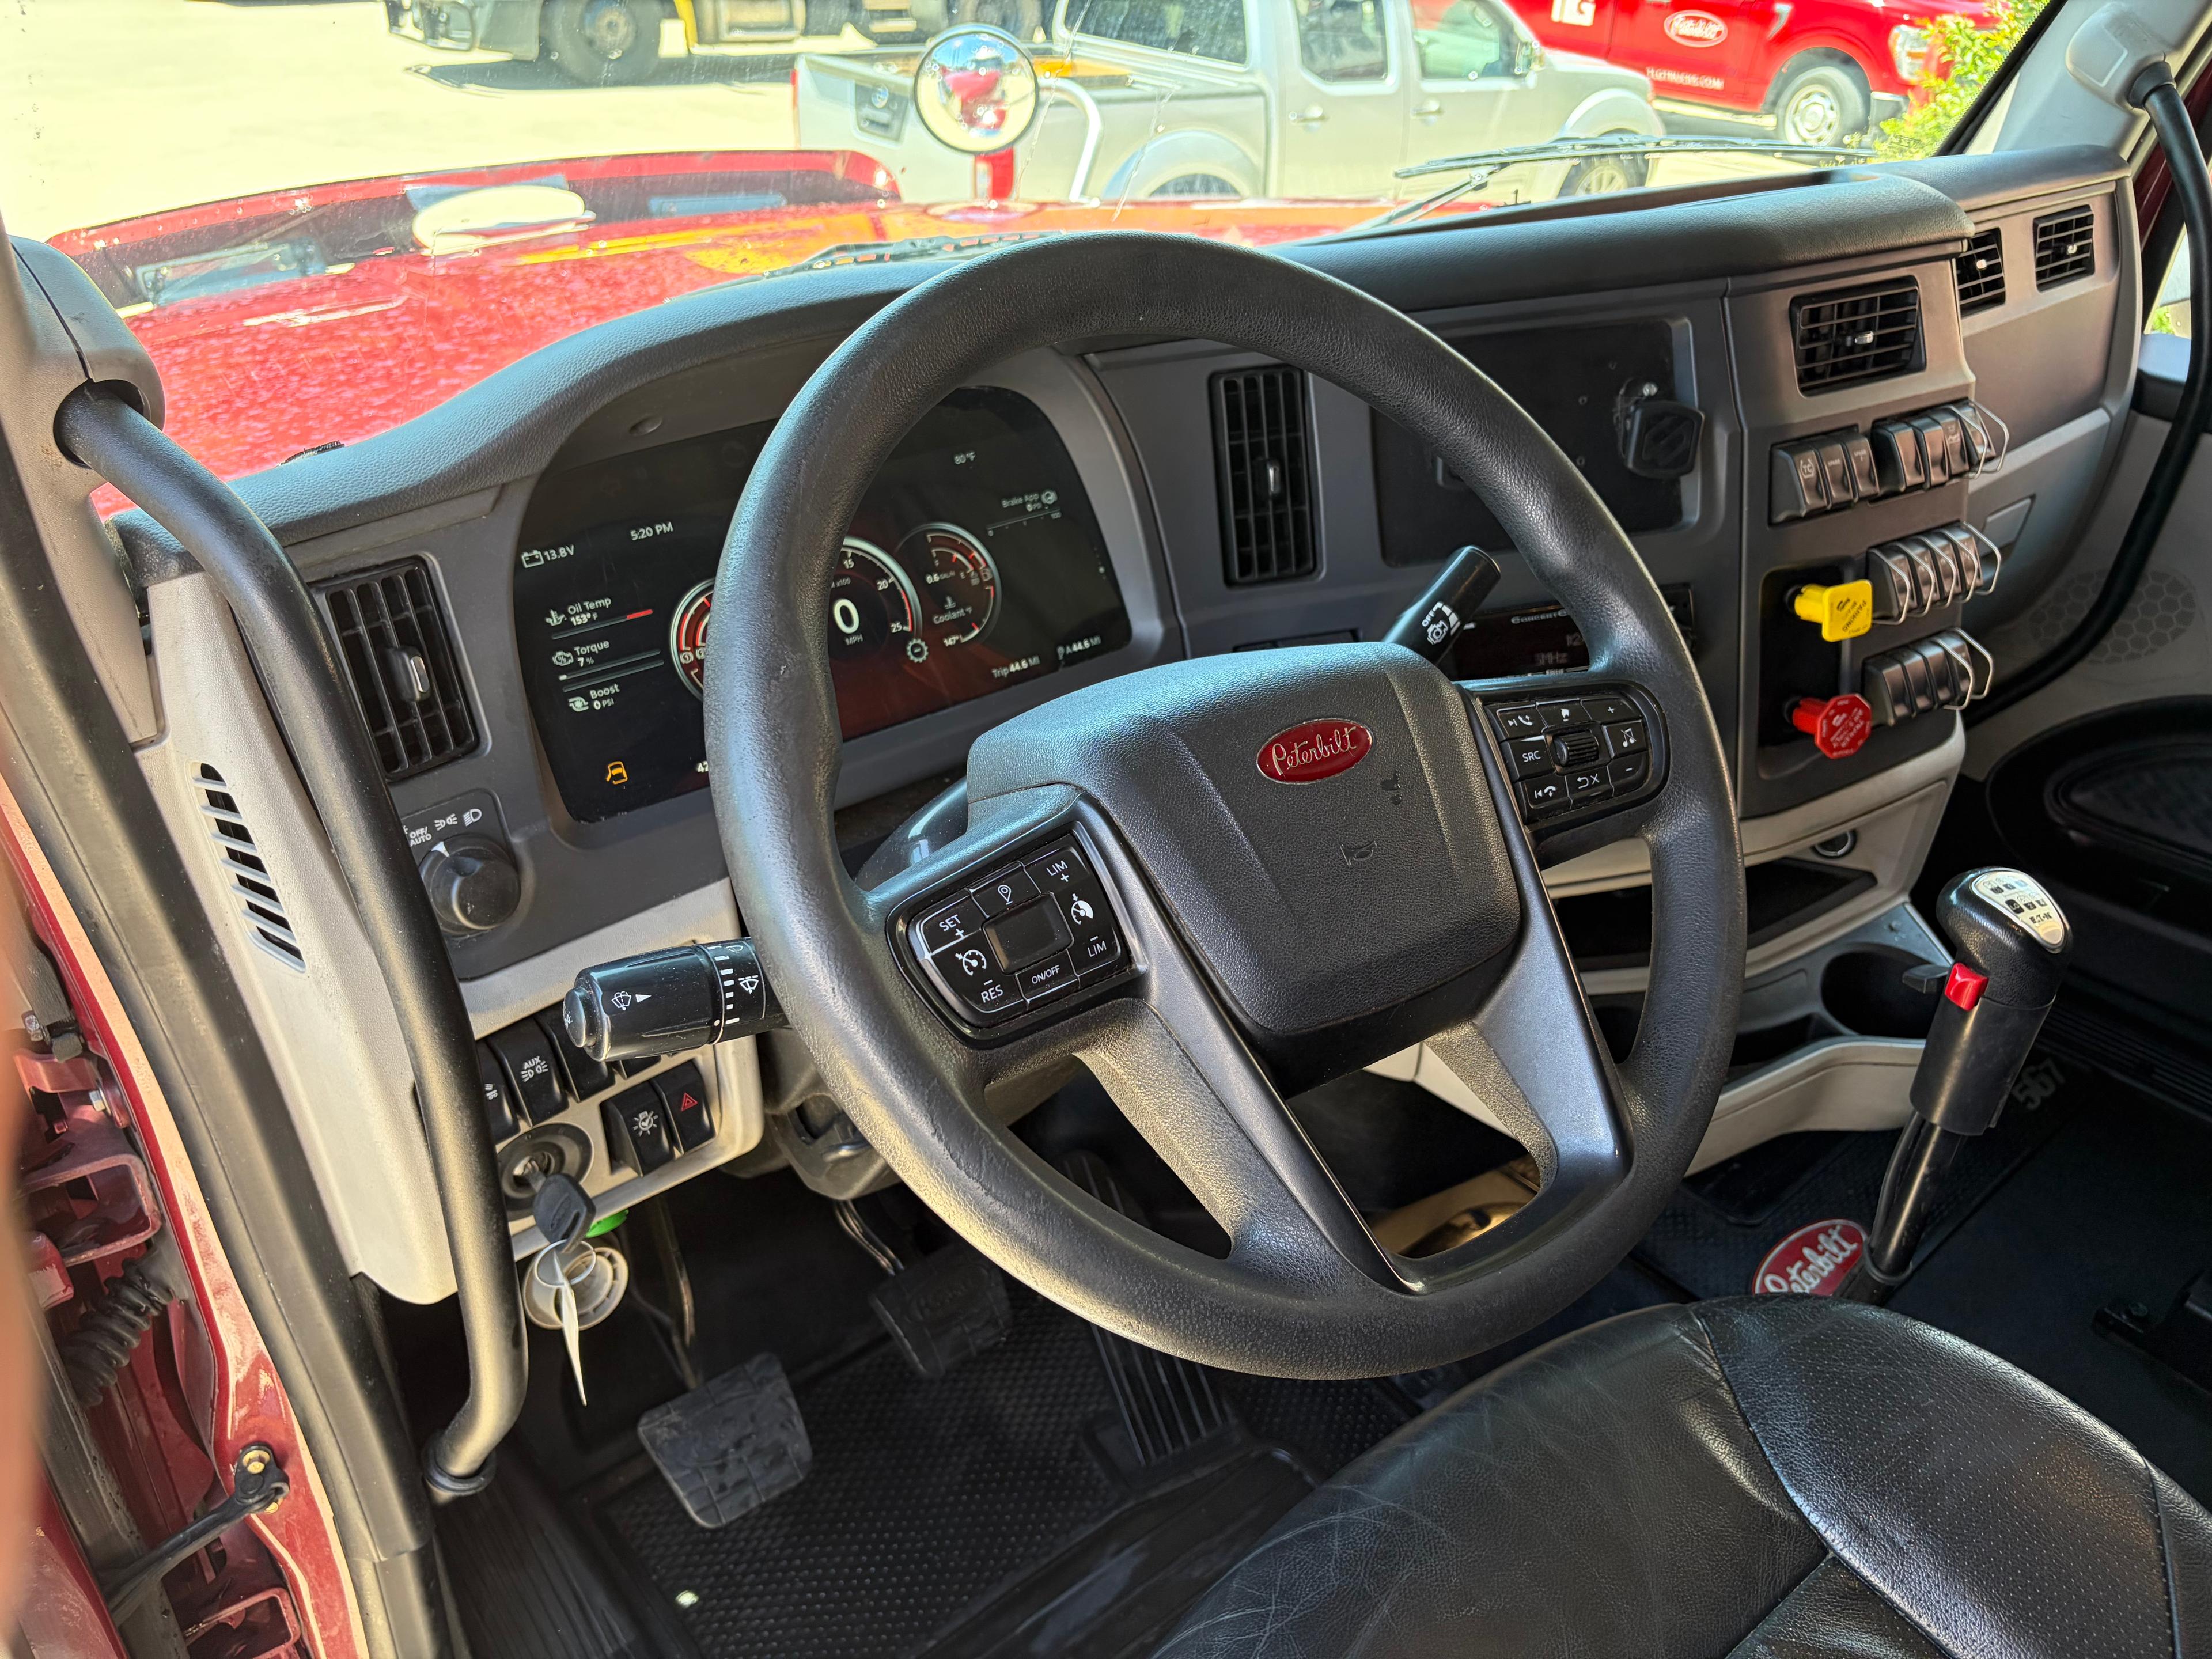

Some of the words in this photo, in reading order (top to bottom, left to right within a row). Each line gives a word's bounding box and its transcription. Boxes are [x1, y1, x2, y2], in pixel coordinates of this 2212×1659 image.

[630, 527, 653, 540] 5:20
[655, 521, 673, 535] PM
[544, 544, 575, 561] 13.8V
[843, 559, 854, 569] 15
[876, 580, 889, 590] 20
[567, 602, 581, 615] Oil
[583, 597, 612, 610] Temp
[833, 598, 859, 634] 0
[933, 609, 965, 624] Coolant
[1422, 609, 1434, 627] OFF
[891, 622, 903, 633] 25
[574, 640, 610, 656] Torque
[844, 634, 863, 646] MPH
[1072, 638, 1091, 652] 44.6
[1090, 635, 1101, 646] MI
[577, 657, 584, 667] 7
[991, 668, 1009, 678] Trip
[1009, 658, 1029, 673] 44.6
[1028, 655, 1040, 667] MI
[590, 683, 620, 699] Boost
[593, 700, 601, 710] 0
[602, 698, 614, 708] PSI
[1272, 726, 1357, 776] Peterbilt
[1522, 751, 1541, 762] SRC
[409, 833, 432, 847] AUTO
[410, 826, 428, 839] OFF/
[1046, 859, 1068, 877] LIM
[938, 914, 961, 933] SET
[1088, 940, 1107, 958] LIM
[1031, 965, 1060, 985] ON/OFF
[980, 984, 1003, 1003] RES
[524, 1056, 541, 1070] AUX
